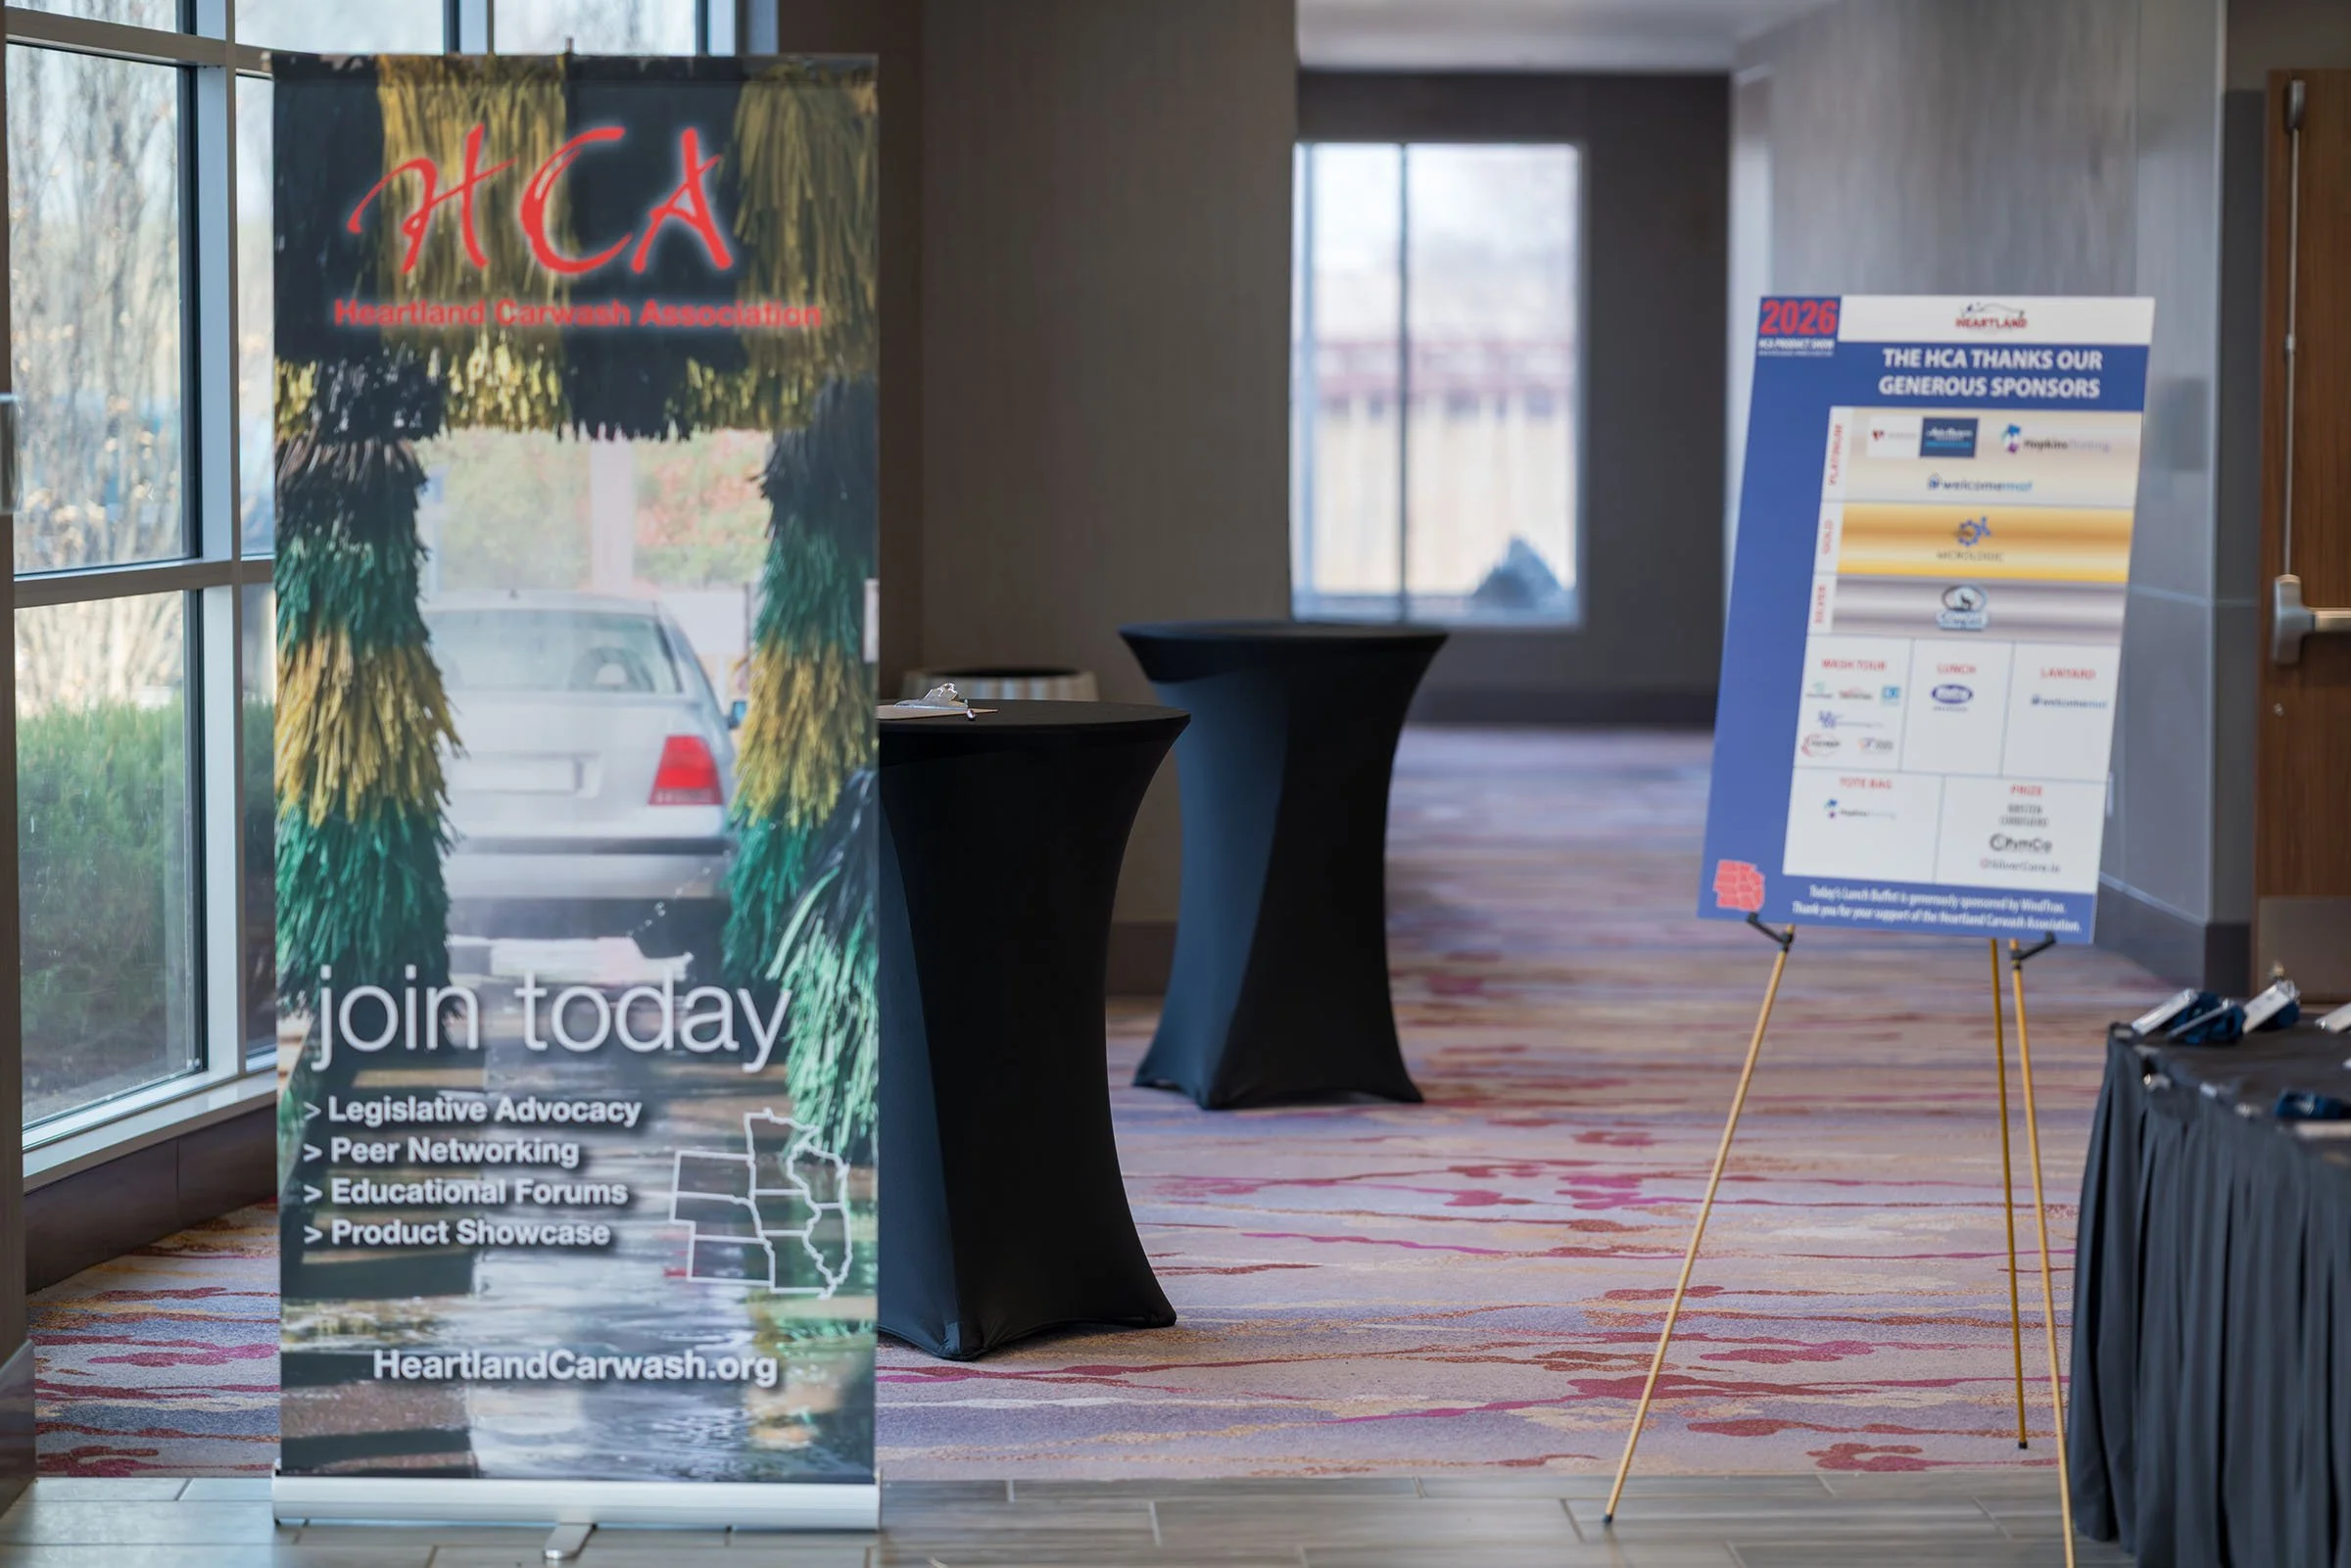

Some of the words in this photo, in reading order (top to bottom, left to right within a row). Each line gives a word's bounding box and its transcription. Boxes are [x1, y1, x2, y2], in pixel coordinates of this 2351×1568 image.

[347, 123, 734, 274] HCA
[334, 299, 485, 326] Heartland
[494, 300, 631, 327] Carwash
[638, 300, 821, 327] Association
[1759, 300, 1838, 335] 2026
[1882, 348, 1923, 368] THE
[1924, 348, 1968, 369] HCA
[1970, 349, 2054, 370] THANKS
[2056, 350, 2103, 371] OUR
[1878, 375, 1988, 397] GENEROUS
[1990, 376, 2101, 399] SPONSORS
[1792, 900, 1819, 916] Thank
[1940, 911, 1984, 927] Heartland
[1986, 913, 2025, 929] Carwash
[311, 964, 480, 1071] join
[514, 967, 792, 1073] today
[328, 1096, 488, 1125] Legislative
[495, 1097, 643, 1128] Advocacy
[330, 1137, 399, 1163] Peer
[407, 1137, 580, 1168] Networking
[330, 1178, 506, 1205] Educational
[515, 1179, 629, 1206] Forums
[330, 1219, 450, 1246] Product
[456, 1219, 611, 1246] Showcase
[372, 1350, 779, 1387] HeartlandCarwash.org
